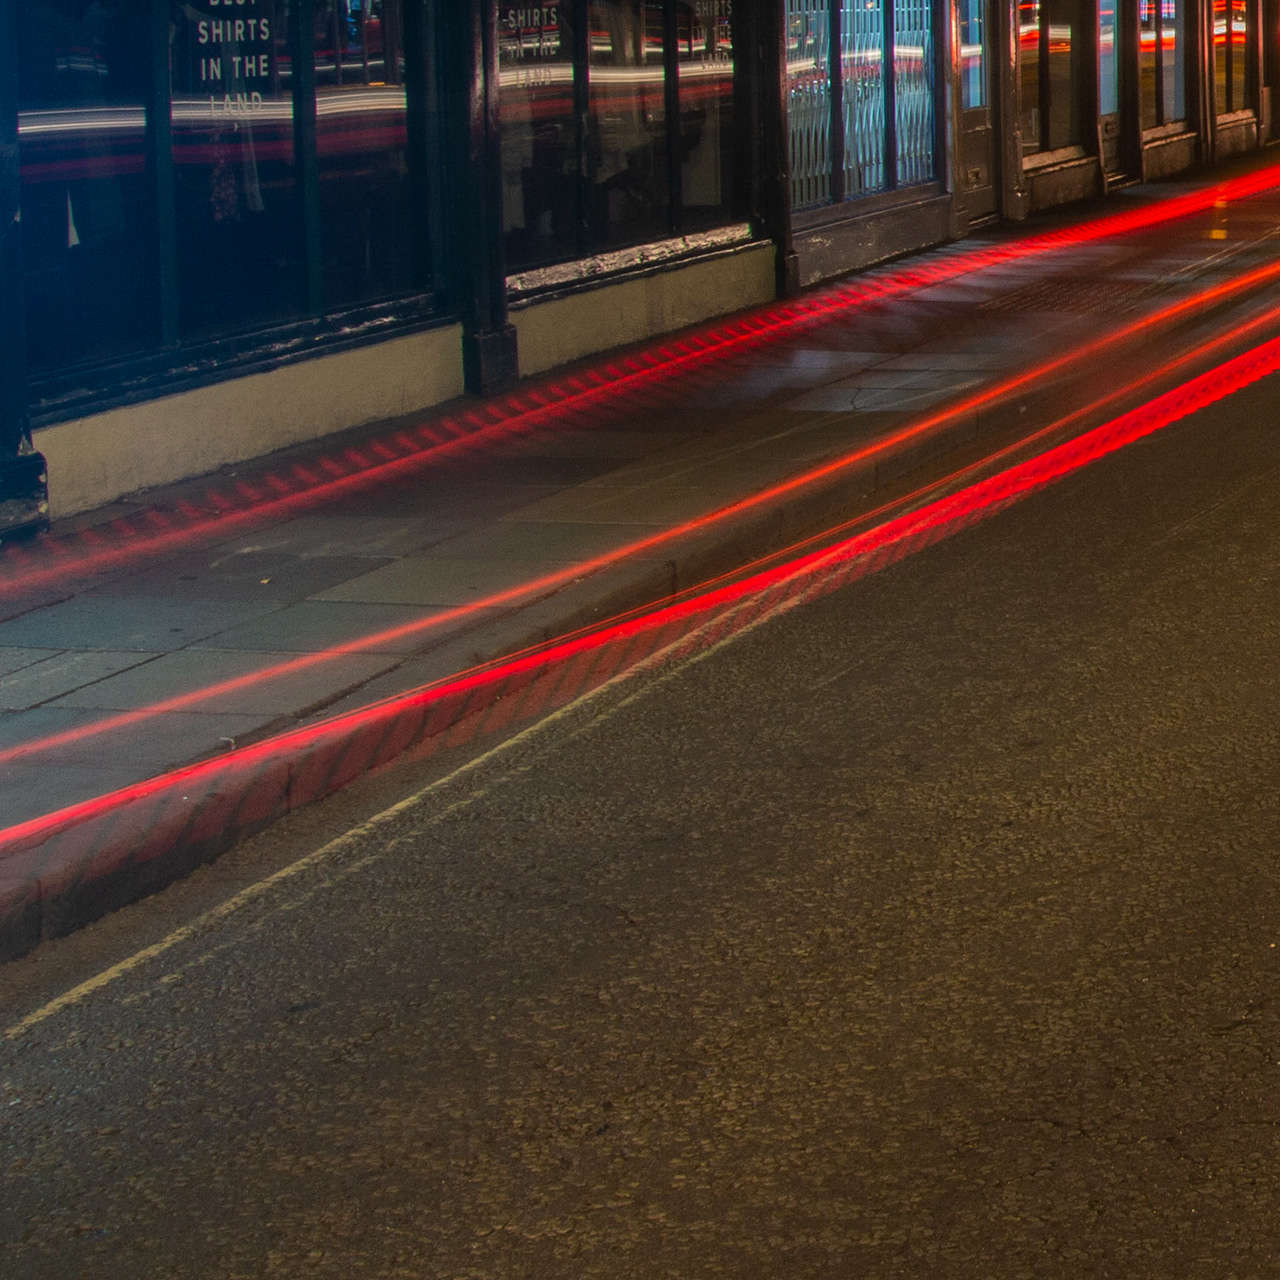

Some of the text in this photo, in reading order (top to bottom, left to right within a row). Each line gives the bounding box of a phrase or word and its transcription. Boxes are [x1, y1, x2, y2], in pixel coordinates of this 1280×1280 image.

[508, 7, 557, 28] SHIRTS
[695, 0, 733, 17] SHIRTS
[198, 18, 270, 44] SHIRTS
[510, 36, 557, 60] IN THE
[201, 54, 269, 81] IN THE
[700, 52, 729, 70] LAND
[517, 68, 551, 90] LAND
[210, 91, 263, 118] LAND
